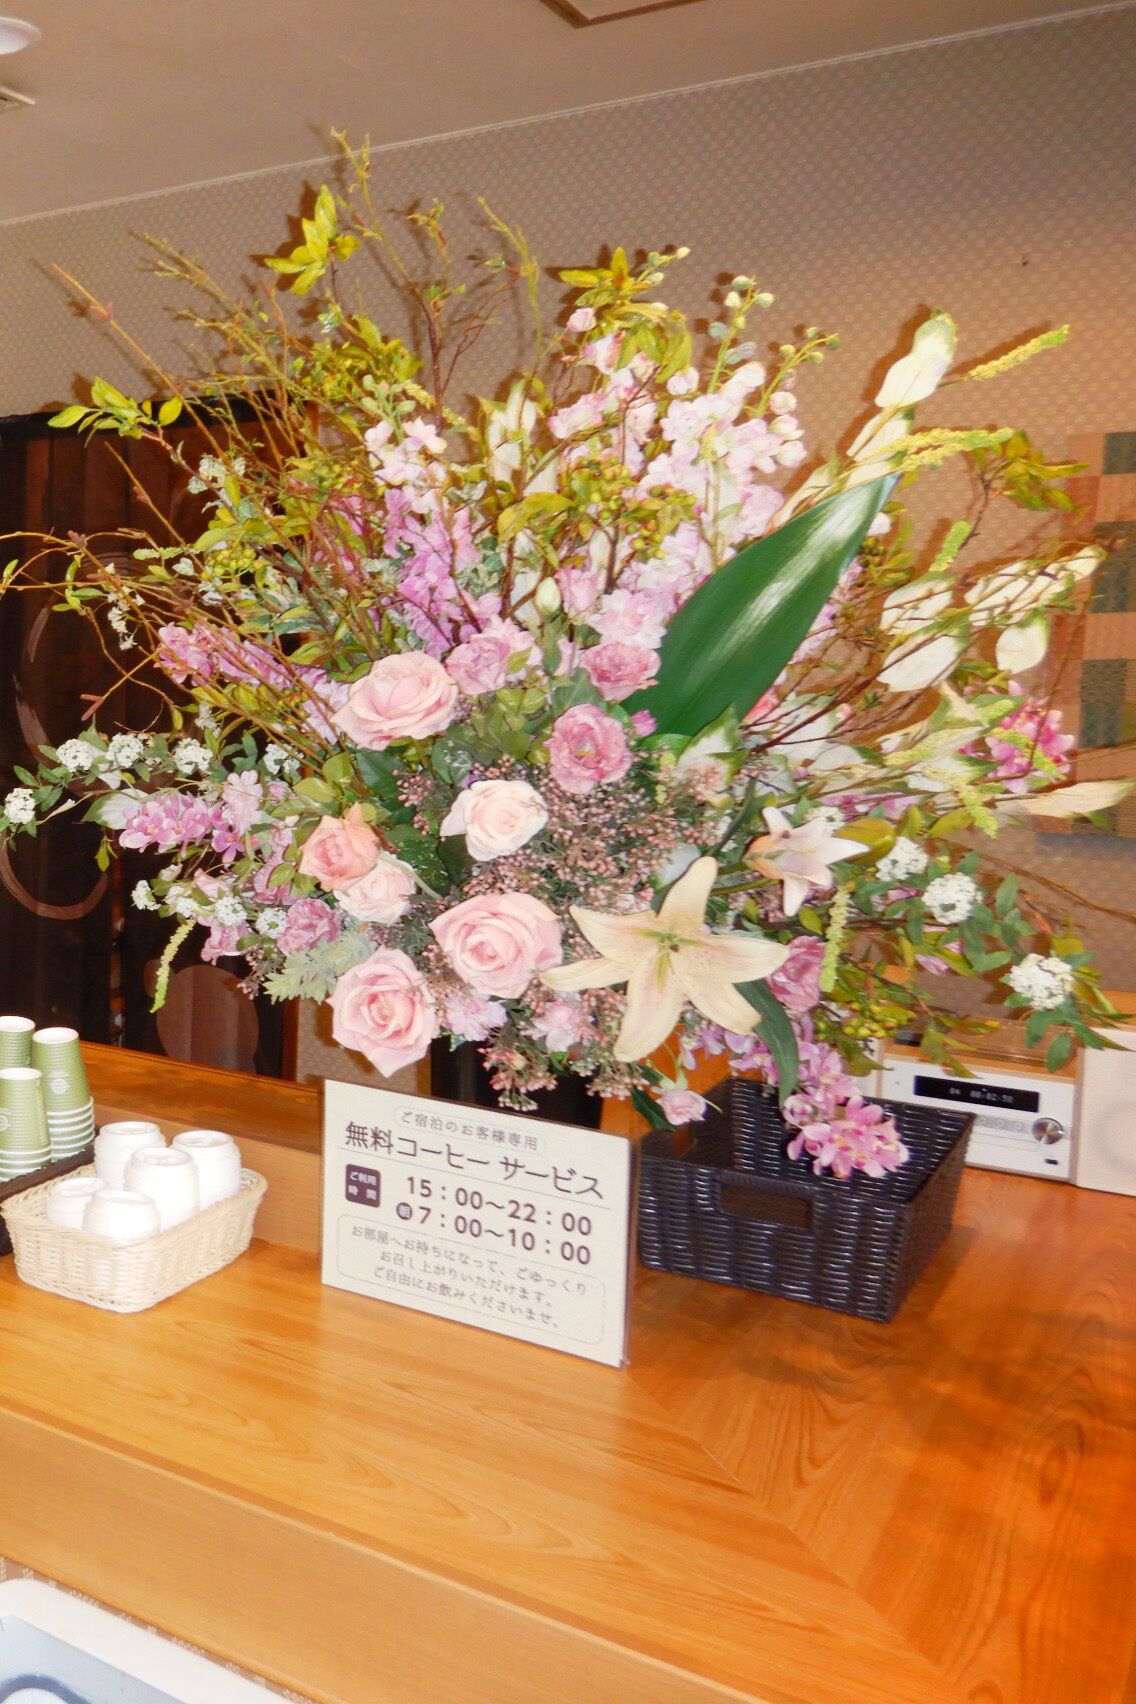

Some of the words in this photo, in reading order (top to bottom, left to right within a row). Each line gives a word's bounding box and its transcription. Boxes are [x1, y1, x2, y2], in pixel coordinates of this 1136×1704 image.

[401, 1111, 539, 1150] ご宿泊のお客様専用
